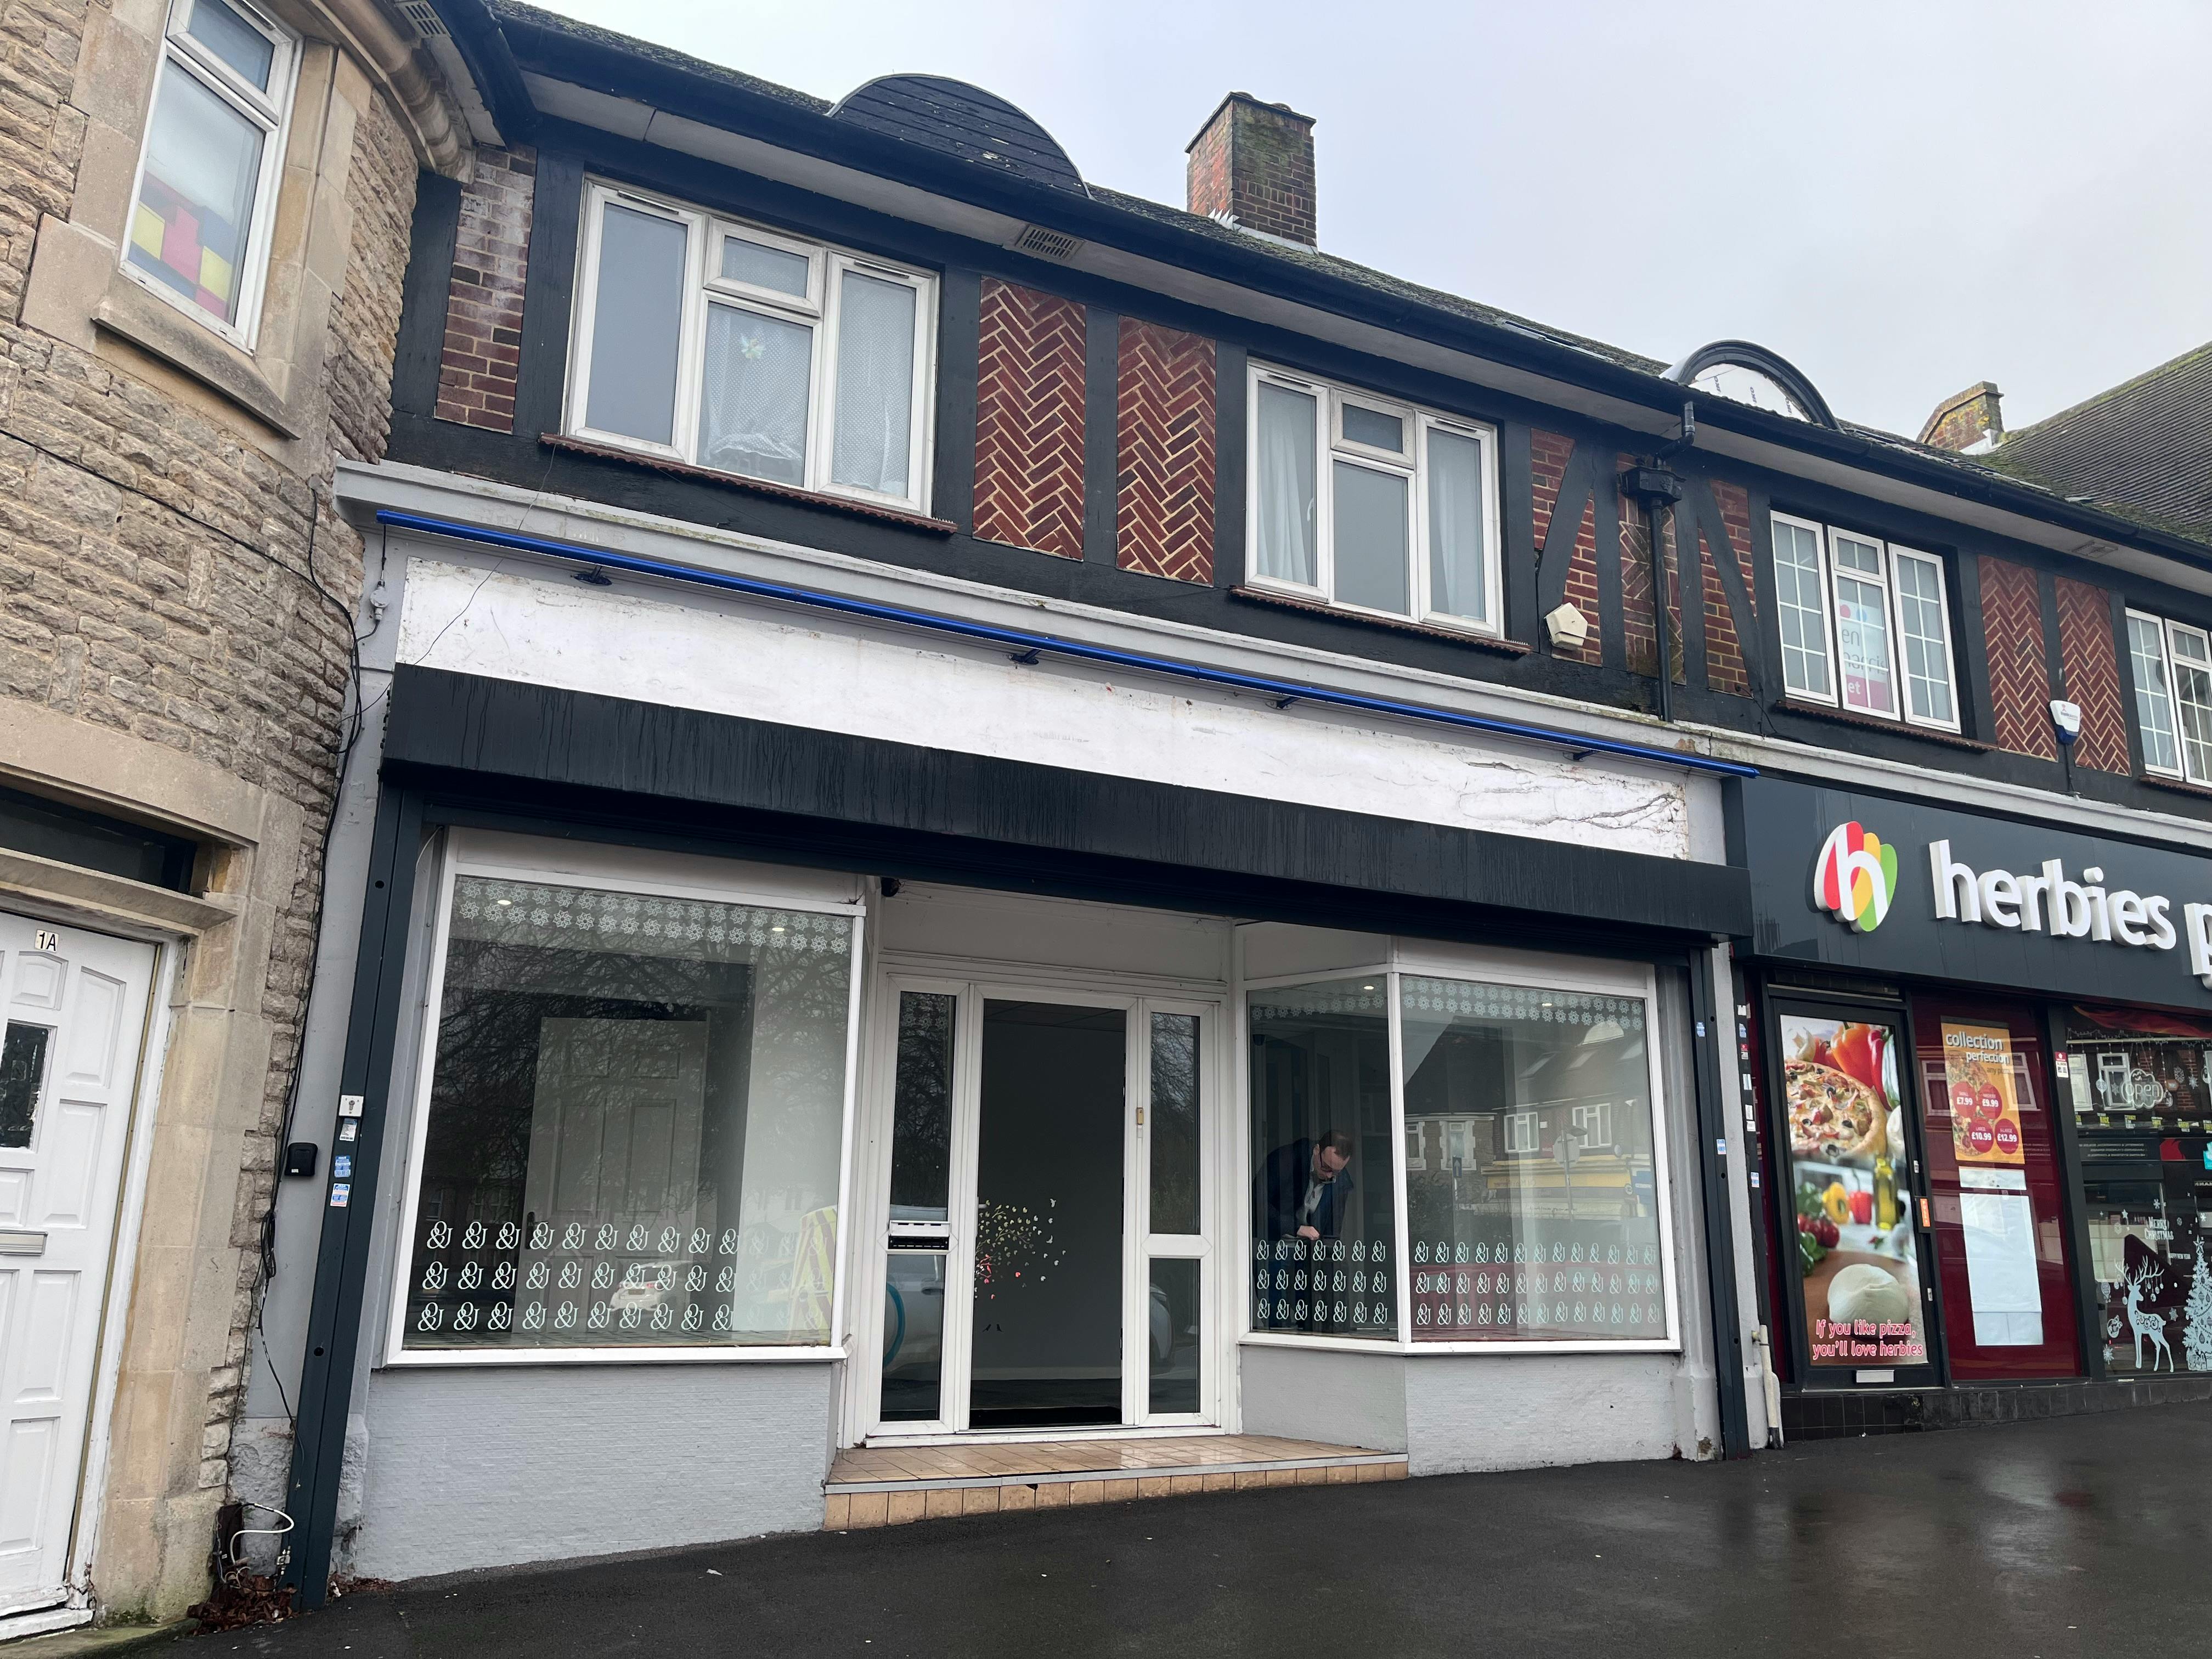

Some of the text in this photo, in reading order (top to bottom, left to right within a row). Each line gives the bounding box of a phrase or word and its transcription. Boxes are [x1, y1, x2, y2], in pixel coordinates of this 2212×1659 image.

[1928, 839, 2177, 951] herbies
[40, 933, 55, 951] 1A
[1946, 1031, 2004, 1051] collection
[1966, 1051, 2010, 1064] perfection
[2125, 1084, 2160, 1099] open
[1956, 1097, 1999, 1107] £7.99 £9.99
[1971, 1132, 2017, 1142] £10.99 £12.99
[2145, 1228, 2174, 1240] CHRISTMAS
[1816, 1319, 1917, 1339] If you like pizza,
[1851, 1341, 1877, 1356] love
[1880, 1341, 1923, 1356] herbies
